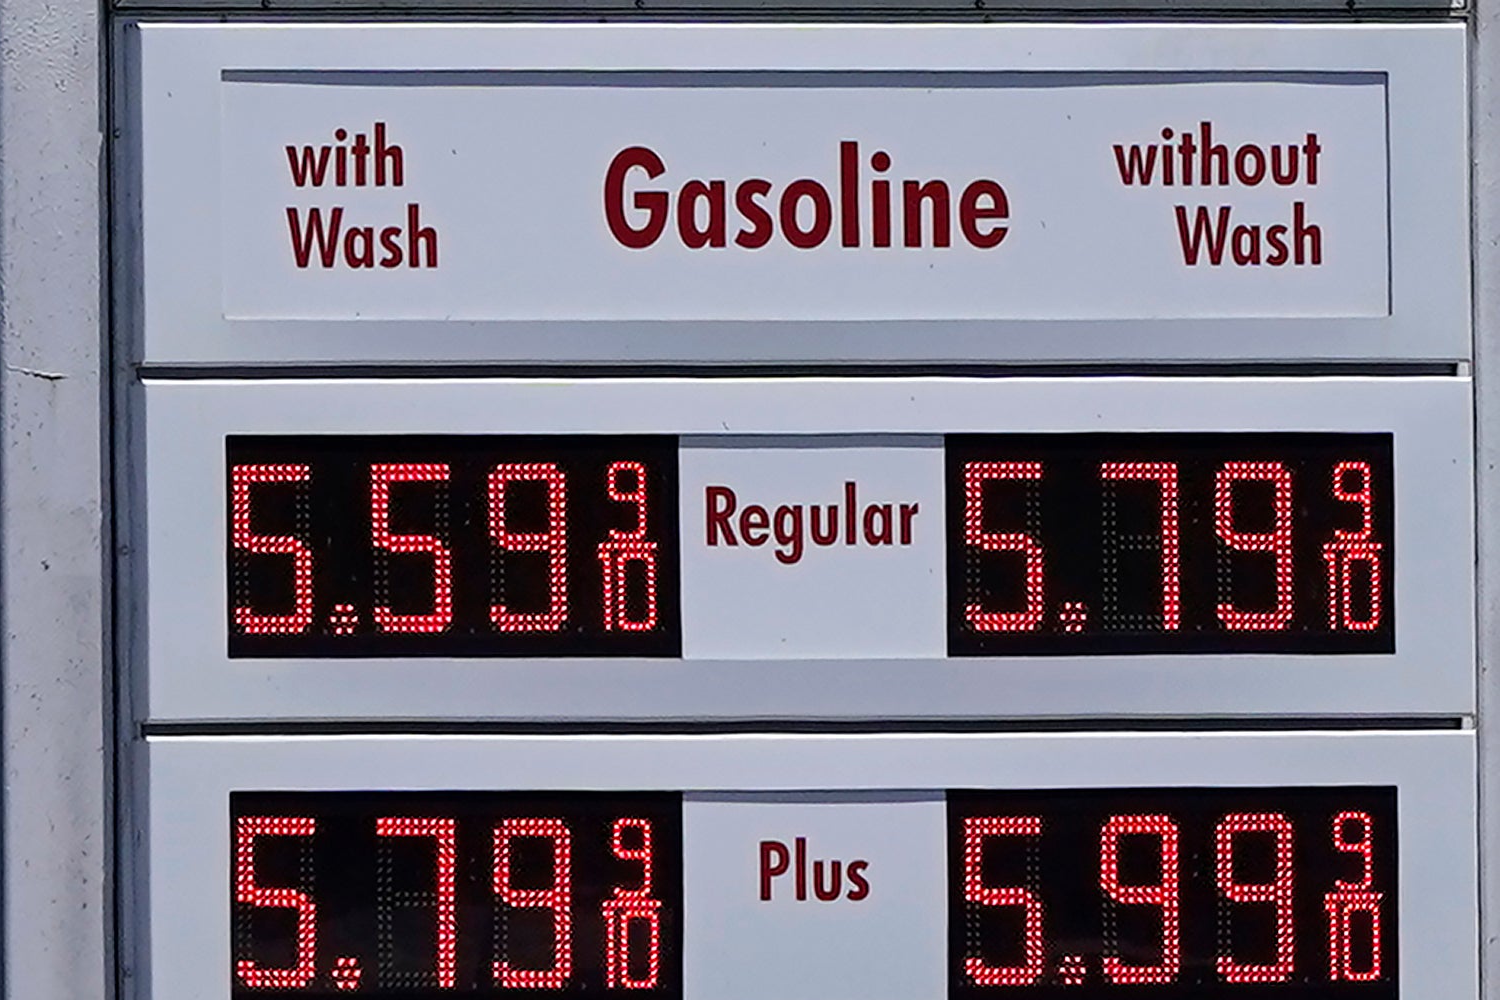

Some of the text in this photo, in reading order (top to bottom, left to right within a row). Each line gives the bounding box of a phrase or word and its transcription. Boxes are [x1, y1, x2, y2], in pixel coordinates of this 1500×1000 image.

[287, 123, 404, 187] with
[603, 140, 1009, 250] Gasoline
[1113, 123, 1321, 187] without
[287, 204, 439, 269] Wash
[1175, 203, 1322, 267] Wash
[231, 462, 569, 636] 5.59
[705, 483, 918, 565] Regular
[964, 460, 1295, 633] 5.79
[234, 815, 574, 991] 5.79
[759, 833, 870, 905] Plus
[963, 812, 1296, 987] 5.99
